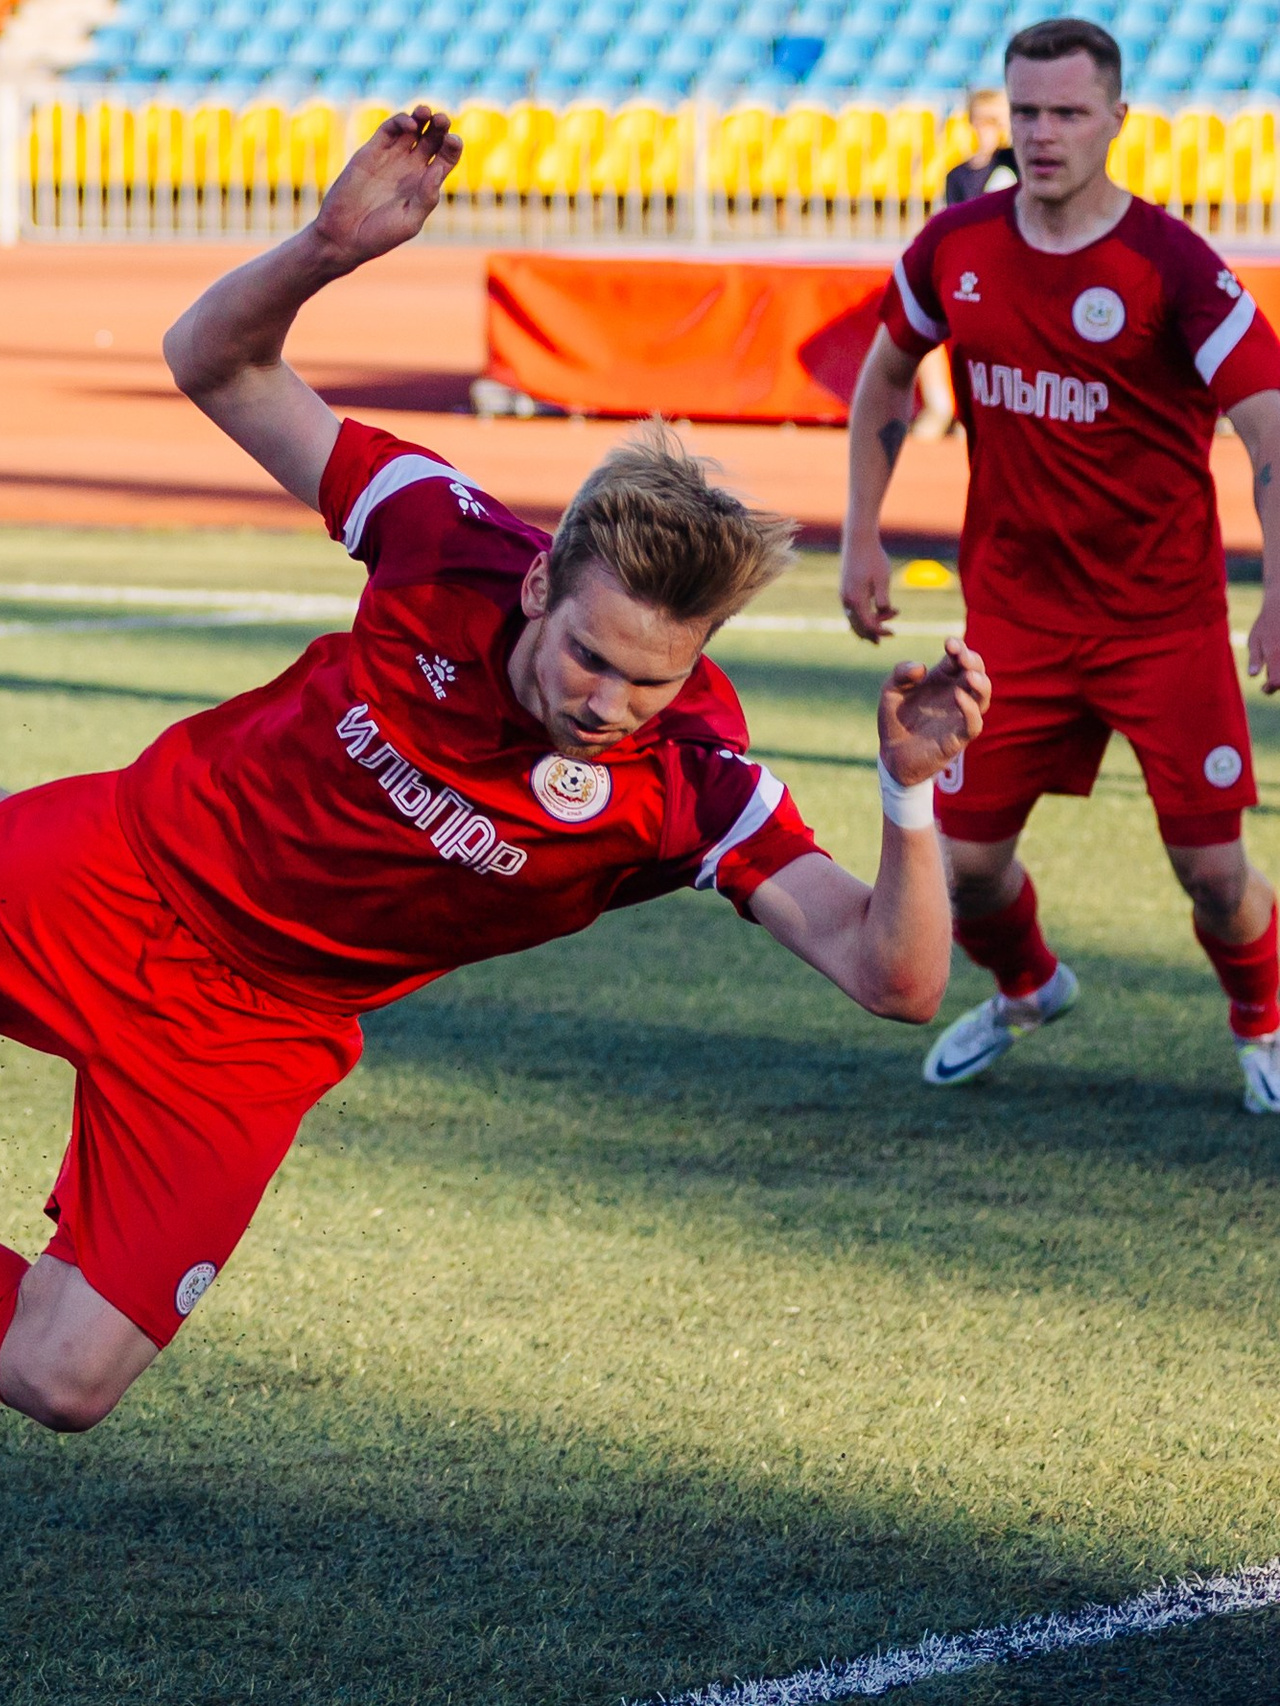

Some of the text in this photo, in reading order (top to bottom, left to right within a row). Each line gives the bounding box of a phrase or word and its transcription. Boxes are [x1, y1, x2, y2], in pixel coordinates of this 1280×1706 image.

[967, 358, 1109, 424] ИЛЬПАР
[415, 653, 447, 700] KELME
[335, 703, 528, 876] ИЛЬПАР
